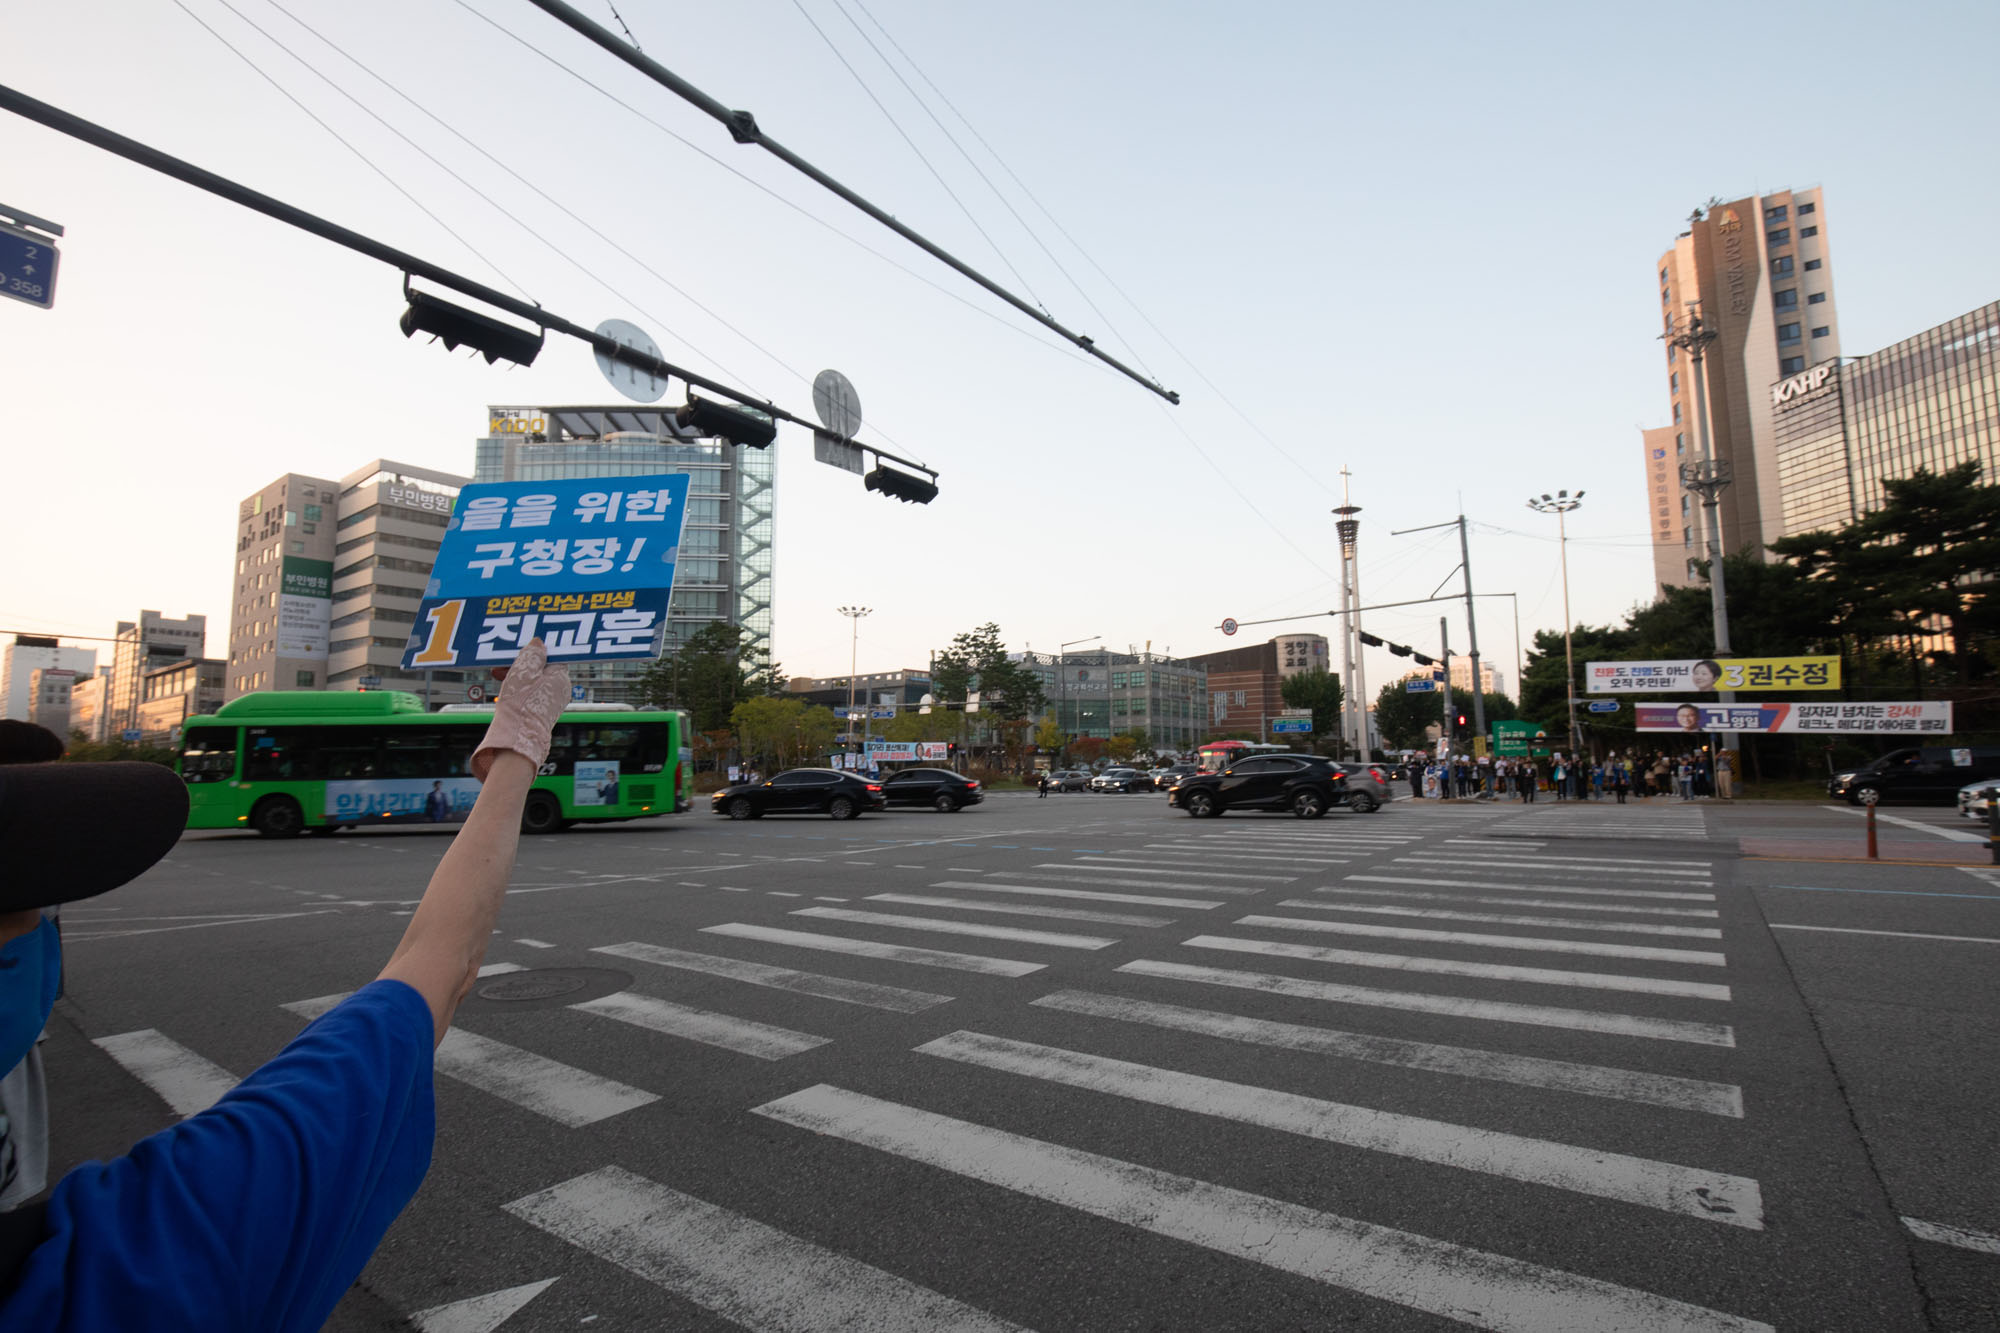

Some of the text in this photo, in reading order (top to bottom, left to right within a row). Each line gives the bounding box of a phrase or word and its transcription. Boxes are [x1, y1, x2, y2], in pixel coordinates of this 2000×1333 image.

[25, 246, 38, 259] 2
[9, 278, 43, 297] 358
[1774, 367, 1831, 404] KAHP
[390, 488, 449, 512] 부민병원
[461, 489, 672, 531] 을을 위한
[467, 537, 647, 579] 구청장!
[486, 591, 636, 615] 안전·안심·민생
[411, 599, 656, 667] 1 진교훈
[1611, 678, 1676, 688] 오직 주민편!
[1666, 666, 1689, 676] 아닌
[1725, 663, 1828, 687] 3 권수정
[1761, 704, 1791, 733] 7
[1798, 705, 1923, 718] 일자리 넘치는 강서!
[1798, 719, 1946, 731] 테크노 메디컬 에어로 밸리
